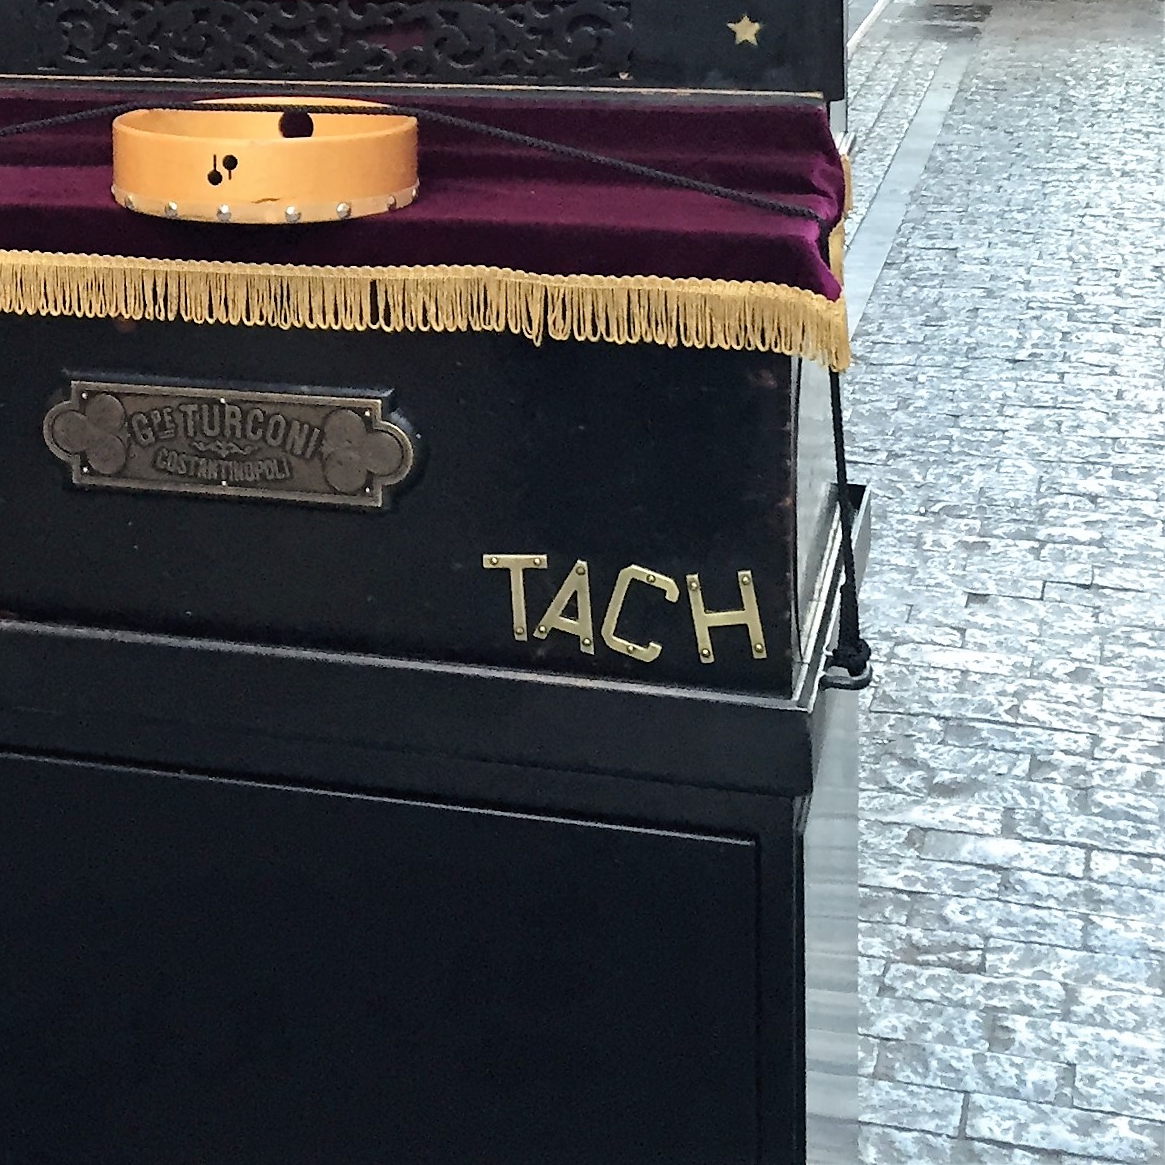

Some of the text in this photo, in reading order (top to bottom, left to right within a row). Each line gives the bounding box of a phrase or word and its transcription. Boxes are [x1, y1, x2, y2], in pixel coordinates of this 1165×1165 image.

[178, 402, 323, 460] TURCONI
[156, 447, 294, 481] COSTANTINOPOLI
[482, 553, 768, 665] TACH
